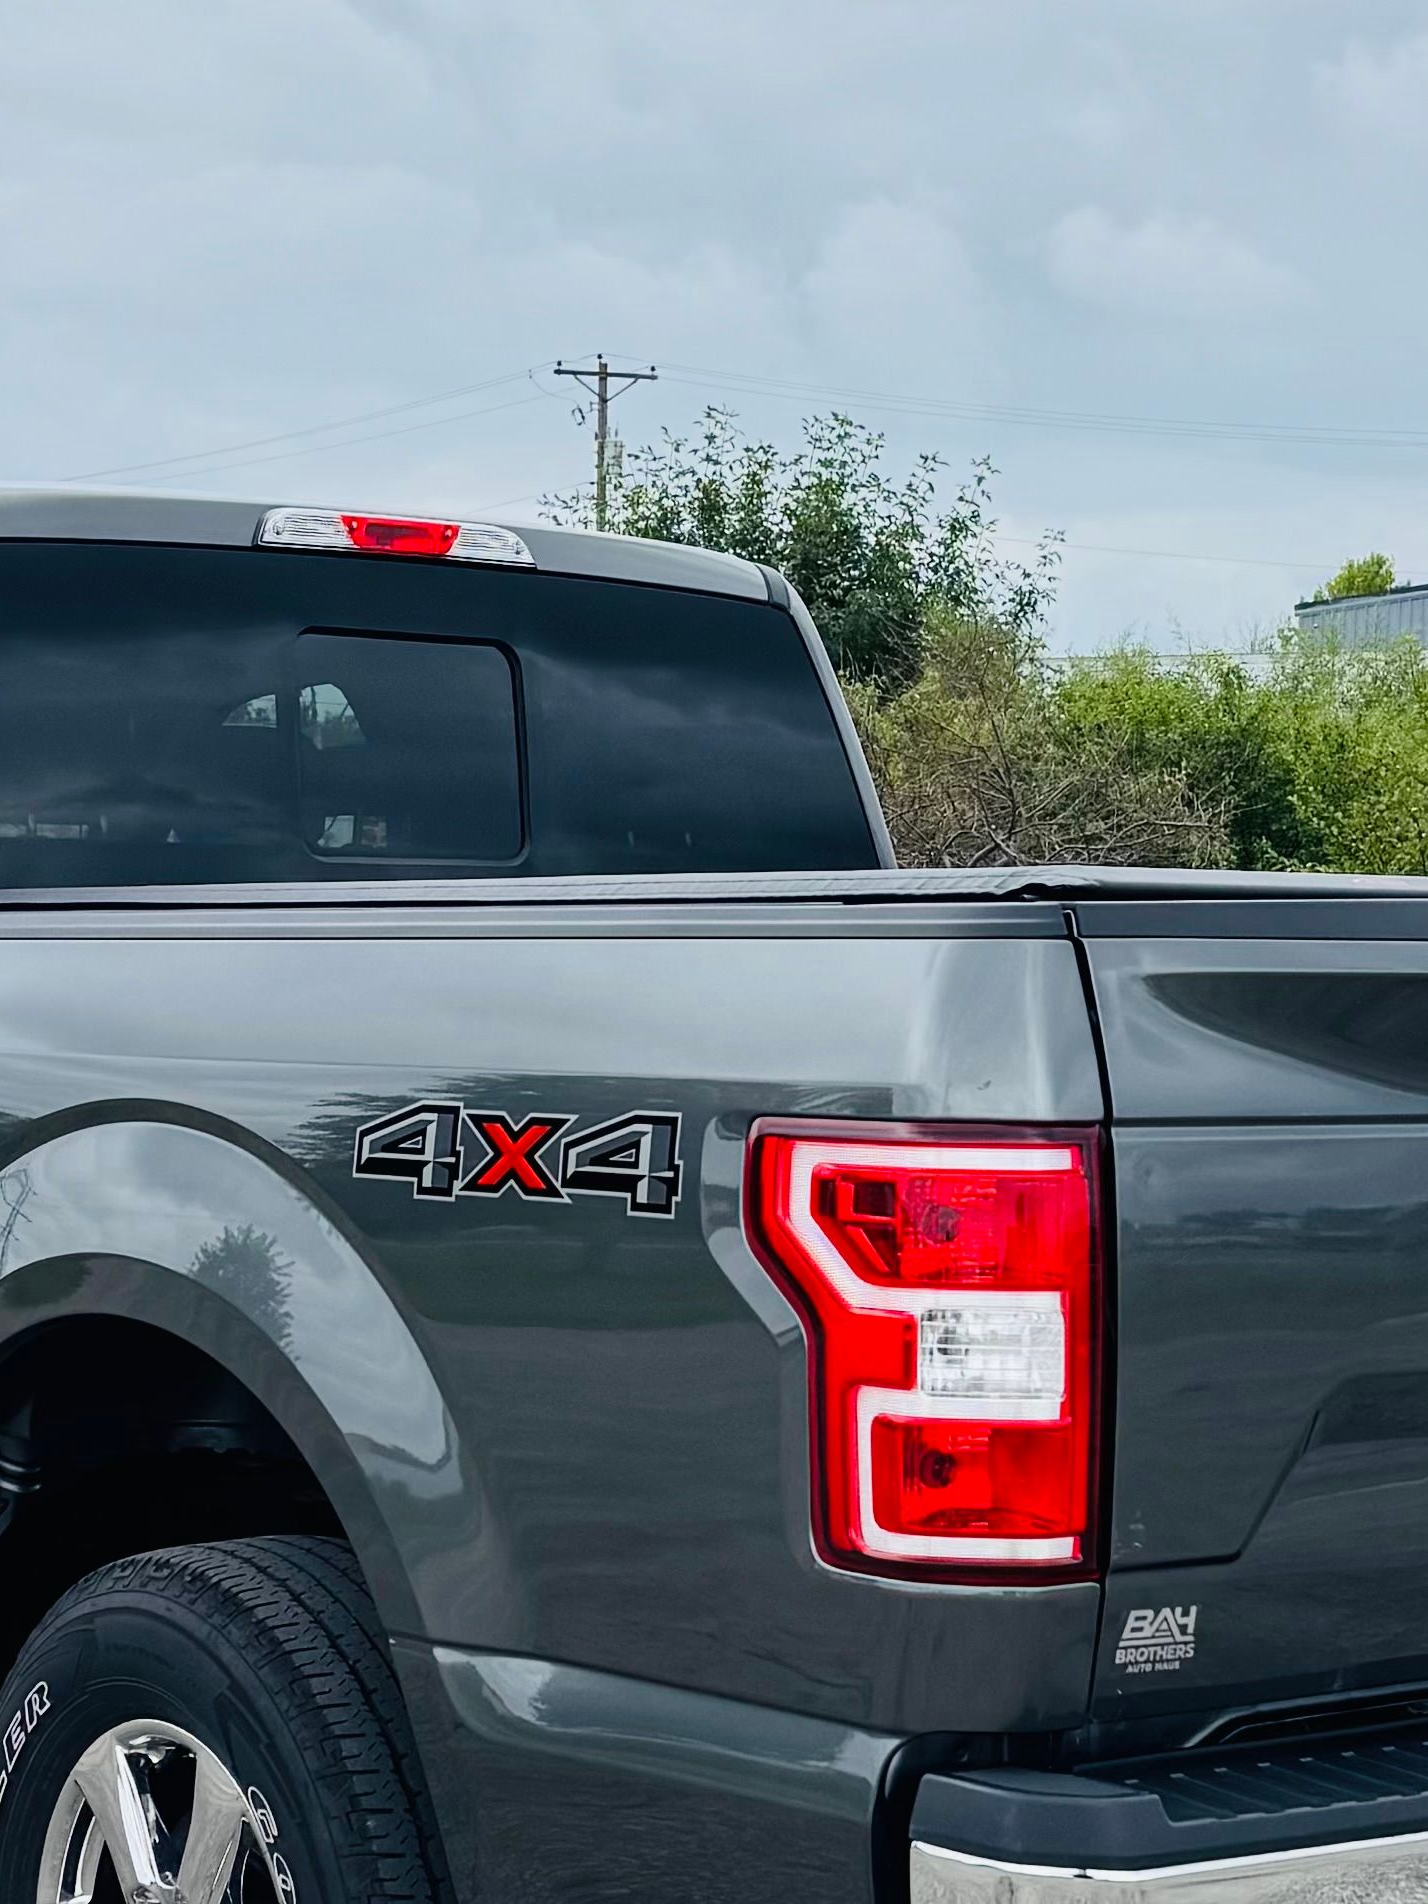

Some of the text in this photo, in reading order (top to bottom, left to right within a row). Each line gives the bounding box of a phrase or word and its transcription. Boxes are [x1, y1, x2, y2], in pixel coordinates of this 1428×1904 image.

[1115, 1643, 1196, 1665] BROTHERS
[1125, 1660, 1181, 1674] AUTO HAUS
